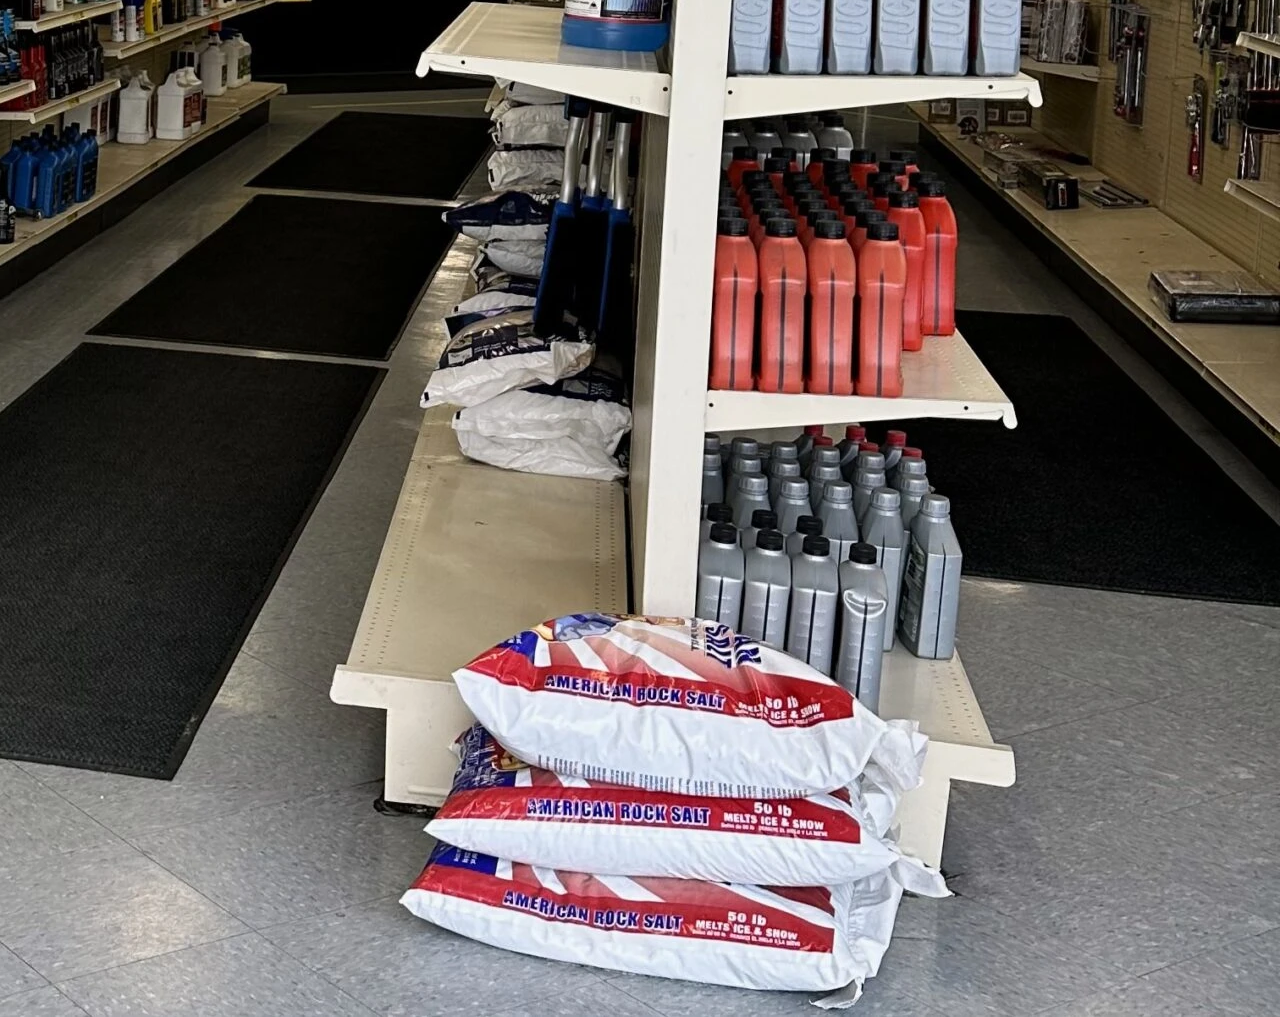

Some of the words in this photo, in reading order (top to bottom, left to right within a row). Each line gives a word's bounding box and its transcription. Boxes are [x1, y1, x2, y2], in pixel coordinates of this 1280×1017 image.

[545, 675, 631, 699] AMERICAN
[637, 688, 681, 704] ROCK
[686, 691, 726, 710] SALT
[765, 696, 782, 709] 50
[787, 696, 799, 709] lb
[770, 711, 787, 720] ICE
[790, 711, 799, 719] &
[800, 703, 821, 718] SNOW
[527, 798, 615, 819] AMERICAN
[620, 803, 666, 821] ROCK
[671, 807, 710, 825] SALT
[754, 801, 773, 814] 50
[778, 804, 792, 817] lb
[723, 812, 757, 824] MELTS
[760, 816, 778, 826] ICE
[781, 817, 790, 827] &
[792, 819, 824, 830] SNOW
[502, 890, 588, 921] AMERICAN
[593, 911, 638, 928] ROCK
[644, 914, 683, 932] SALT
[728, 911, 747, 923] 50
[752, 914, 767, 926] lb
[695, 920, 730, 932] MELTS
[733, 924, 751, 935] ICE
[754, 926, 762, 936] &
[765, 928, 798, 940] SNOW
